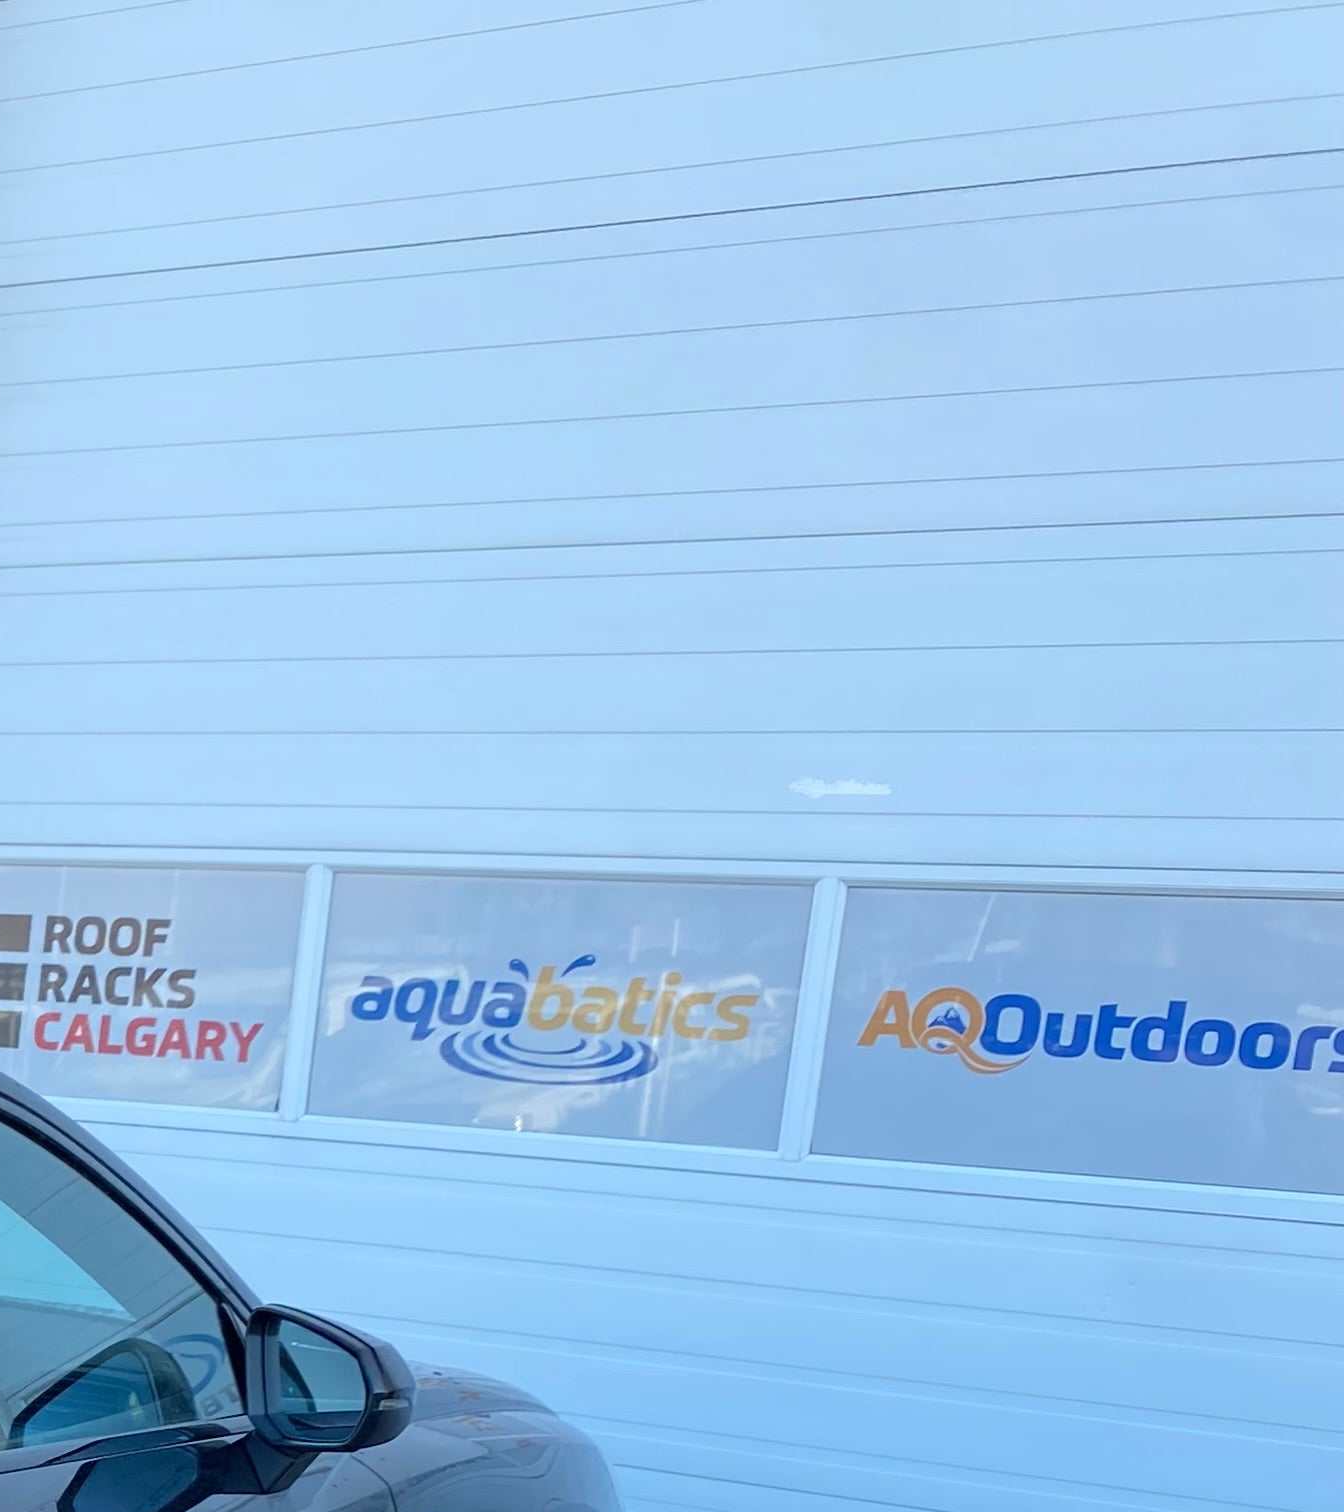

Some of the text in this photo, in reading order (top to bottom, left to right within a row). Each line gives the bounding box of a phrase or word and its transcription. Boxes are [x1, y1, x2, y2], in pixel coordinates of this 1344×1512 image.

[42, 914, 173, 958] ROOF
[37, 963, 197, 1010] RACKS
[350, 965, 761, 1042] aquabatics
[33, 1011, 264, 1063] CALGARY
